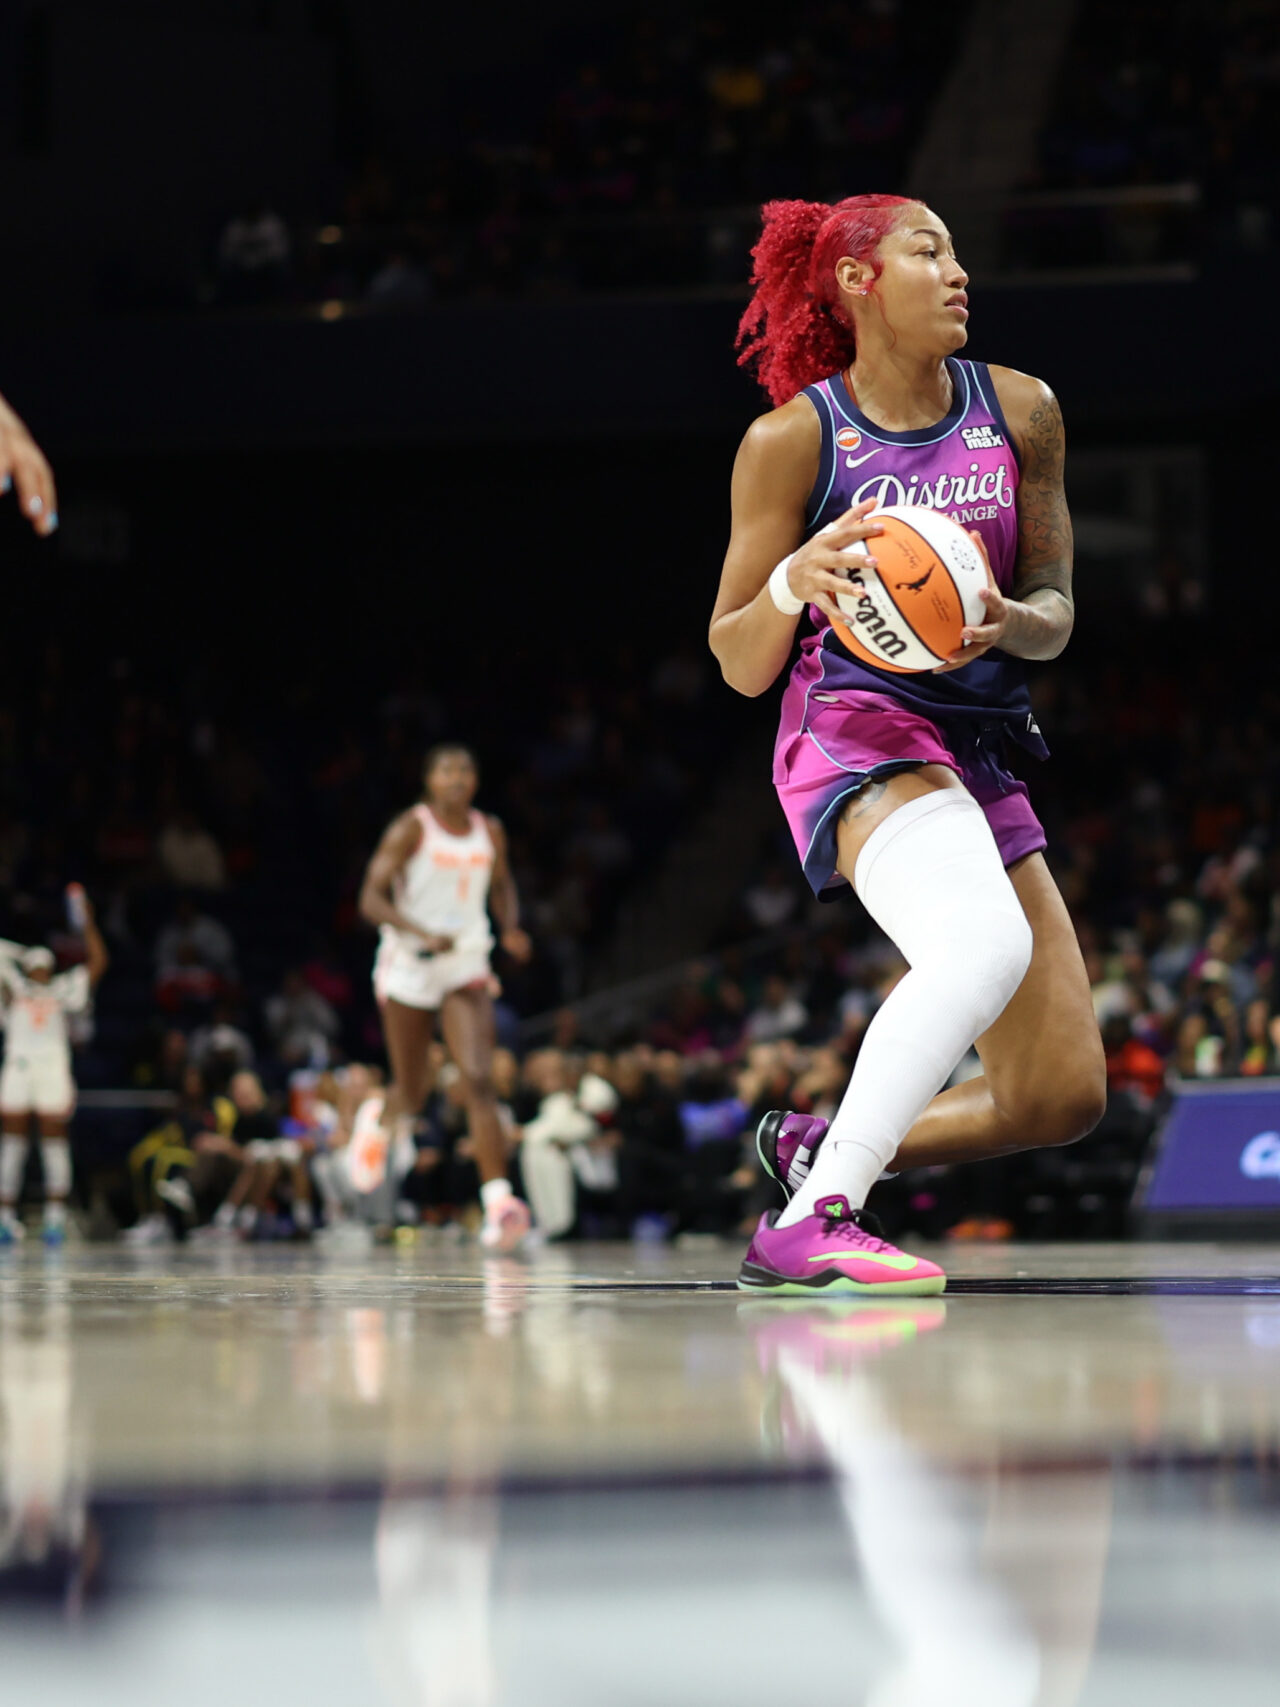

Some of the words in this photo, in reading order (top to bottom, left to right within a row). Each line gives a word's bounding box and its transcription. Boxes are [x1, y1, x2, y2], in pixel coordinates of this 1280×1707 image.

[961, 426, 993, 439] CAR
[851, 463, 1013, 510] District
[944, 505, 998, 525] ANGE
